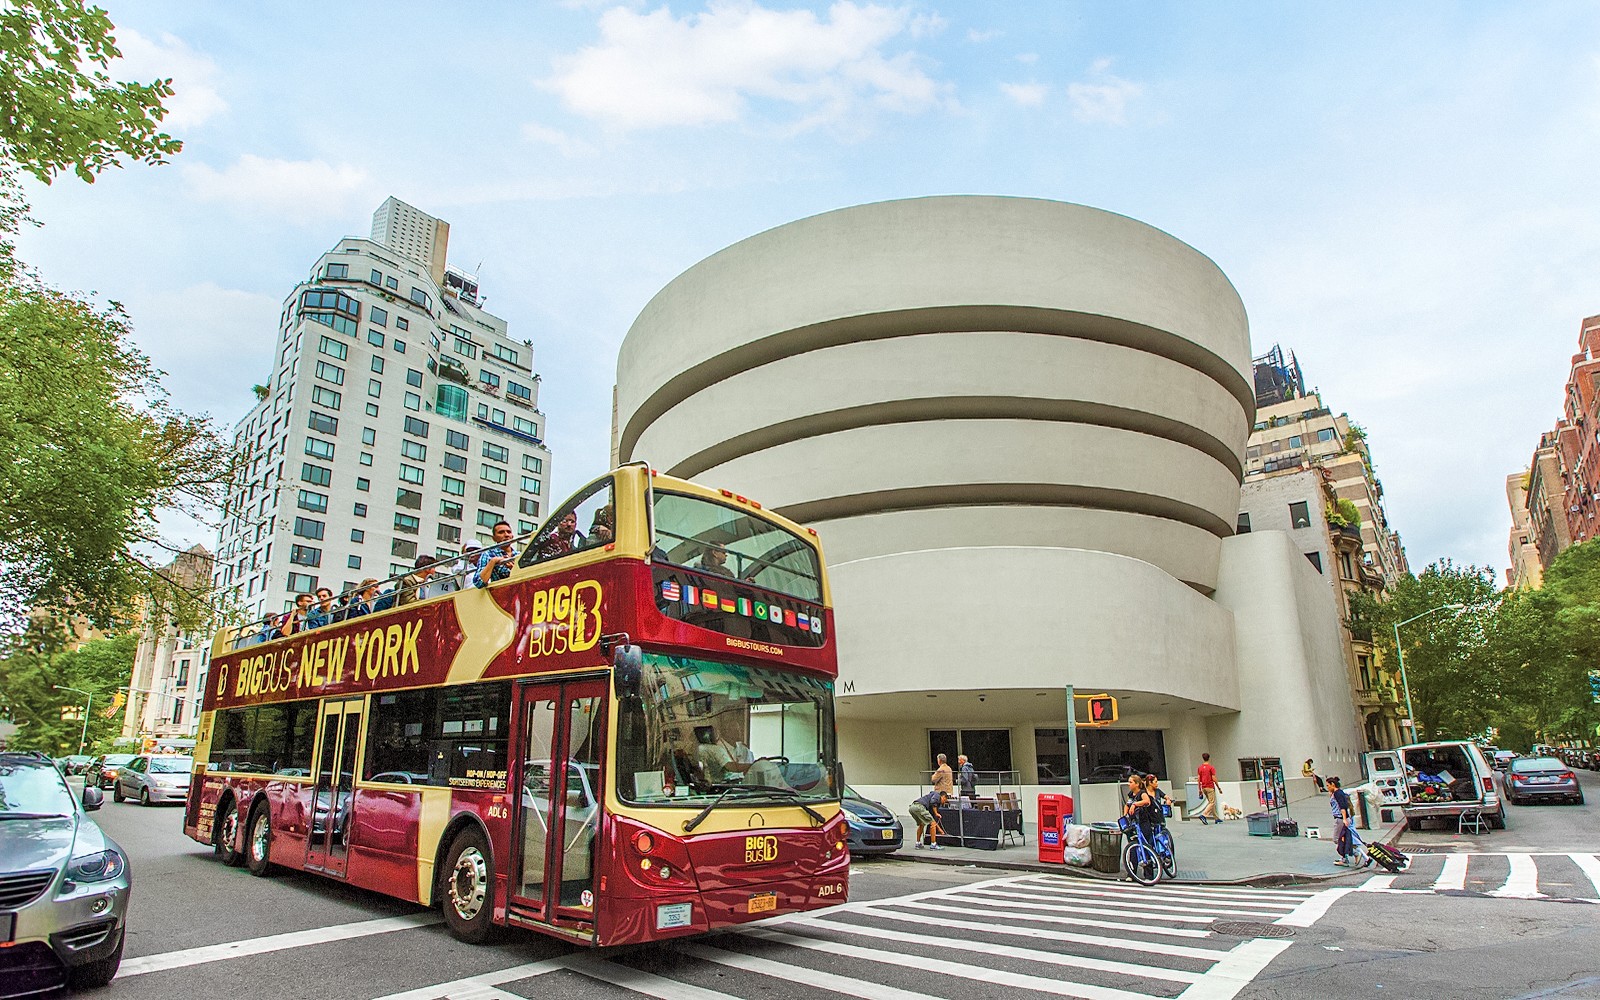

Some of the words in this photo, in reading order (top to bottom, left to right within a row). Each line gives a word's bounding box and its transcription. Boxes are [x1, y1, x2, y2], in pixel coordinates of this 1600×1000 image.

[532, 585, 570, 625] BIG
[529, 622, 567, 658] BUS
[726, 637, 783, 656] BIGBUSTOURS.COM
[297, 635, 350, 689] NEW
[354, 619, 423, 682] YORK
[488, 806, 502, 818] ADL
[502, 808, 508, 819] 6
[745, 837, 764, 850] BIG
[745, 850, 764, 863] BUS
[818, 884, 835, 898] ADL
[836, 883, 842, 893] 6
